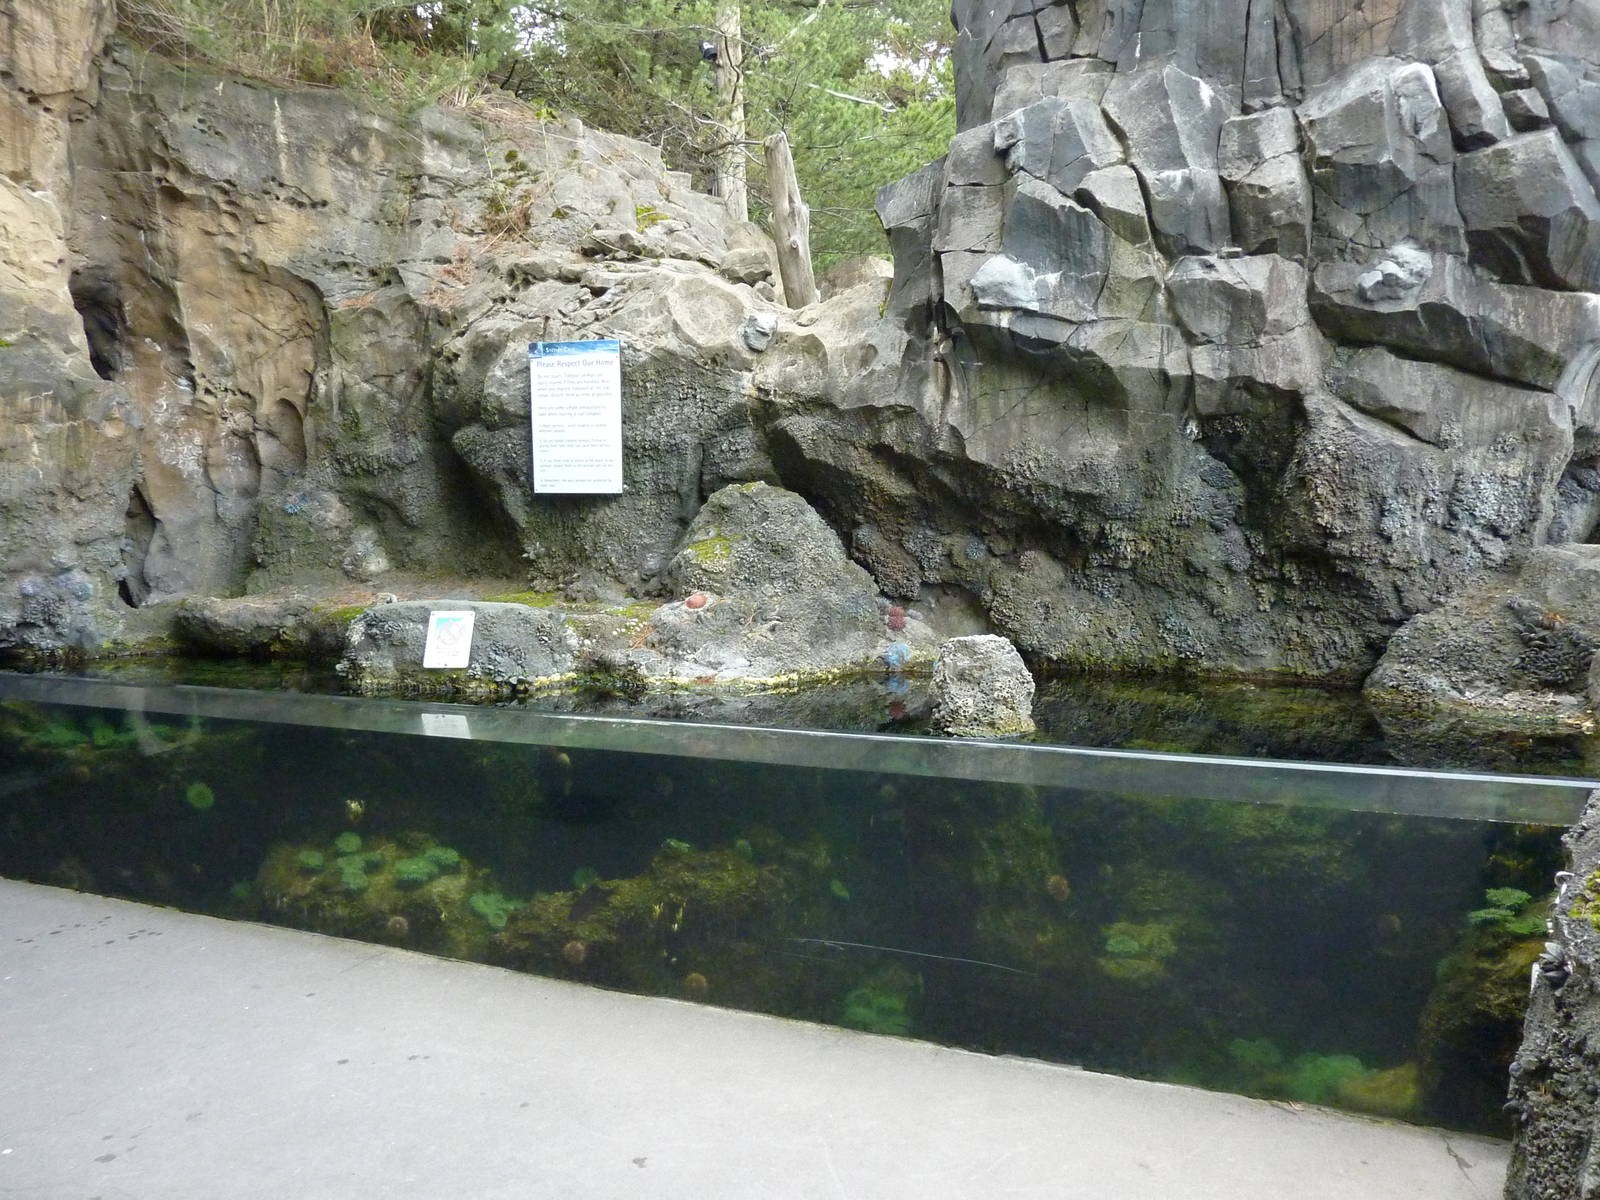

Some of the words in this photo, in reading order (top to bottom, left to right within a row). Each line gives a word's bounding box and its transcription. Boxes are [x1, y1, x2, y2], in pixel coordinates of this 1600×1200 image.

[536, 360, 555, 368] Please
[557, 360, 580, 368] Respect
[582, 359, 594, 367] Our
